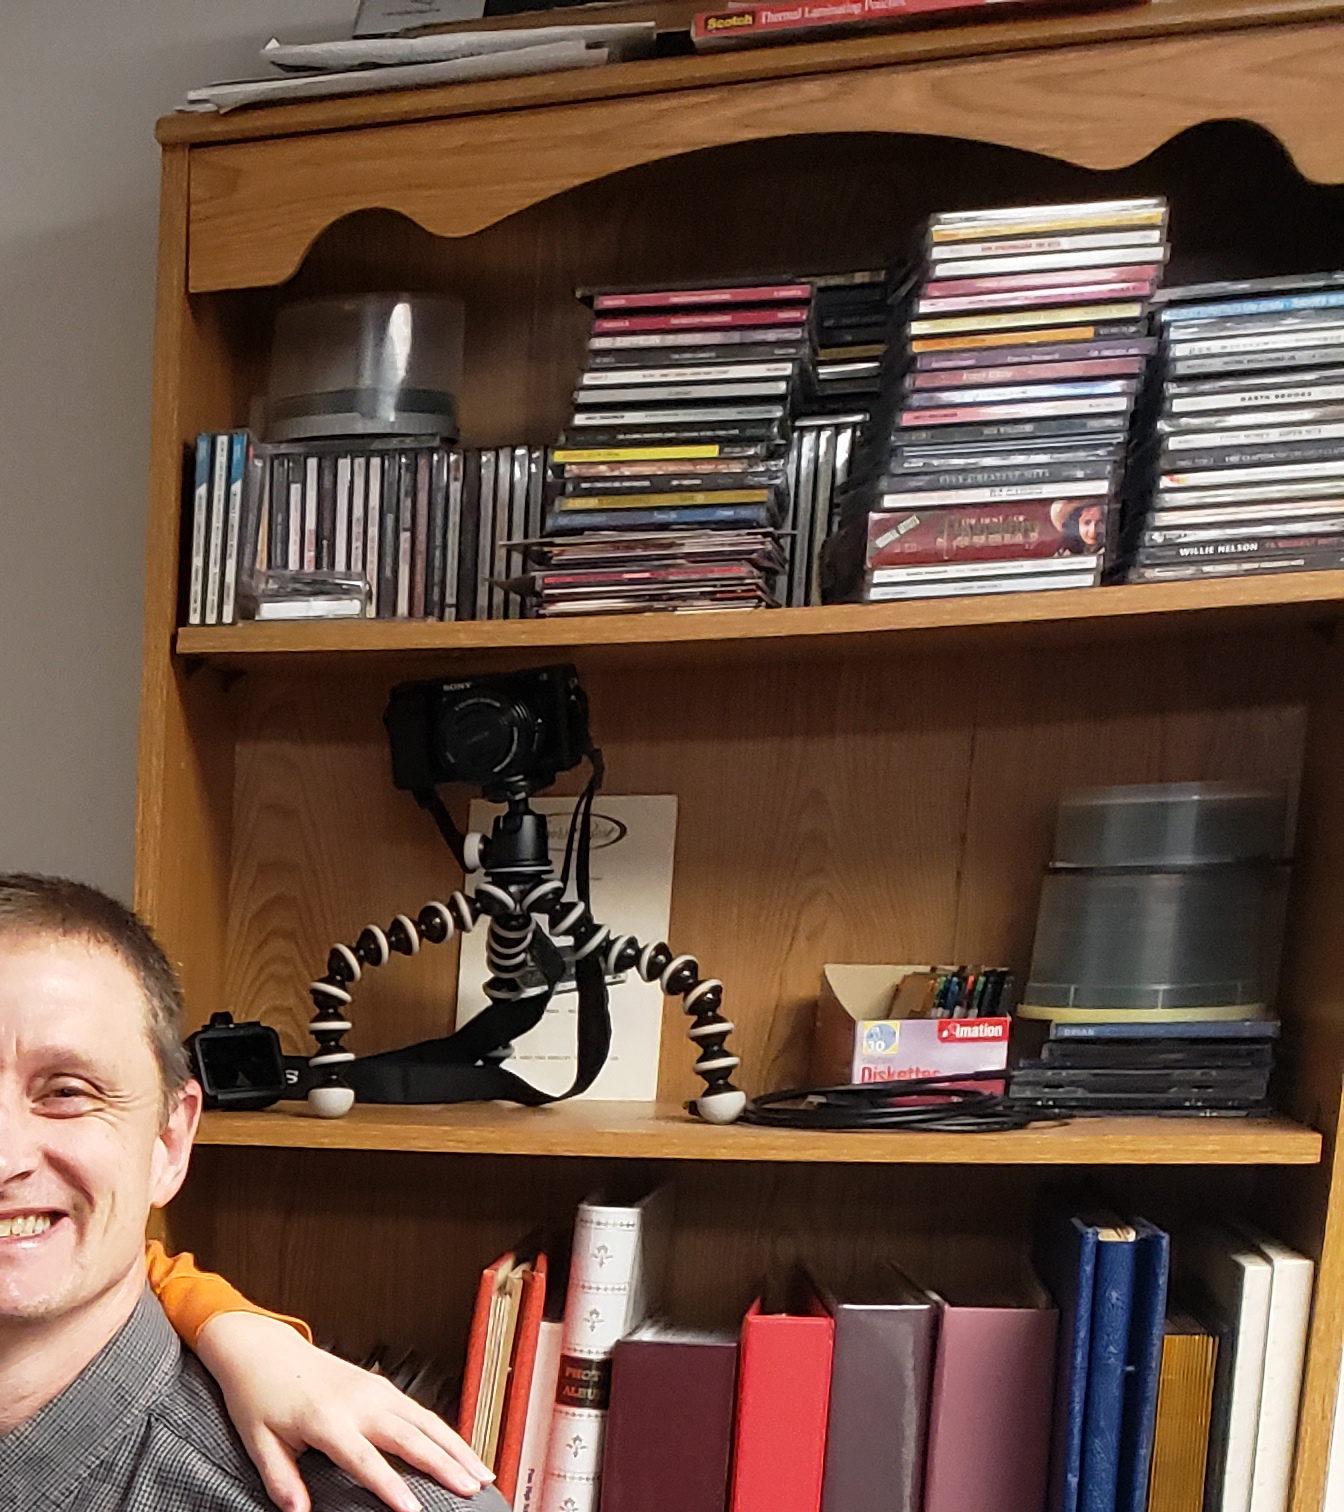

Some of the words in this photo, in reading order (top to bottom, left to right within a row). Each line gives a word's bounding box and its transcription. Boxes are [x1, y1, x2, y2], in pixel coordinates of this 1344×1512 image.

[762, 6, 800, 25] Thermal
[804, 2, 862, 20] Laminating
[707, 15, 754, 31] Scotch
[1179, 544, 1215, 557] WILLIE
[1218, 541, 1258, 555] NELSON
[443, 682, 472, 692] SONY
[955, 1023, 1003, 1038] imation
